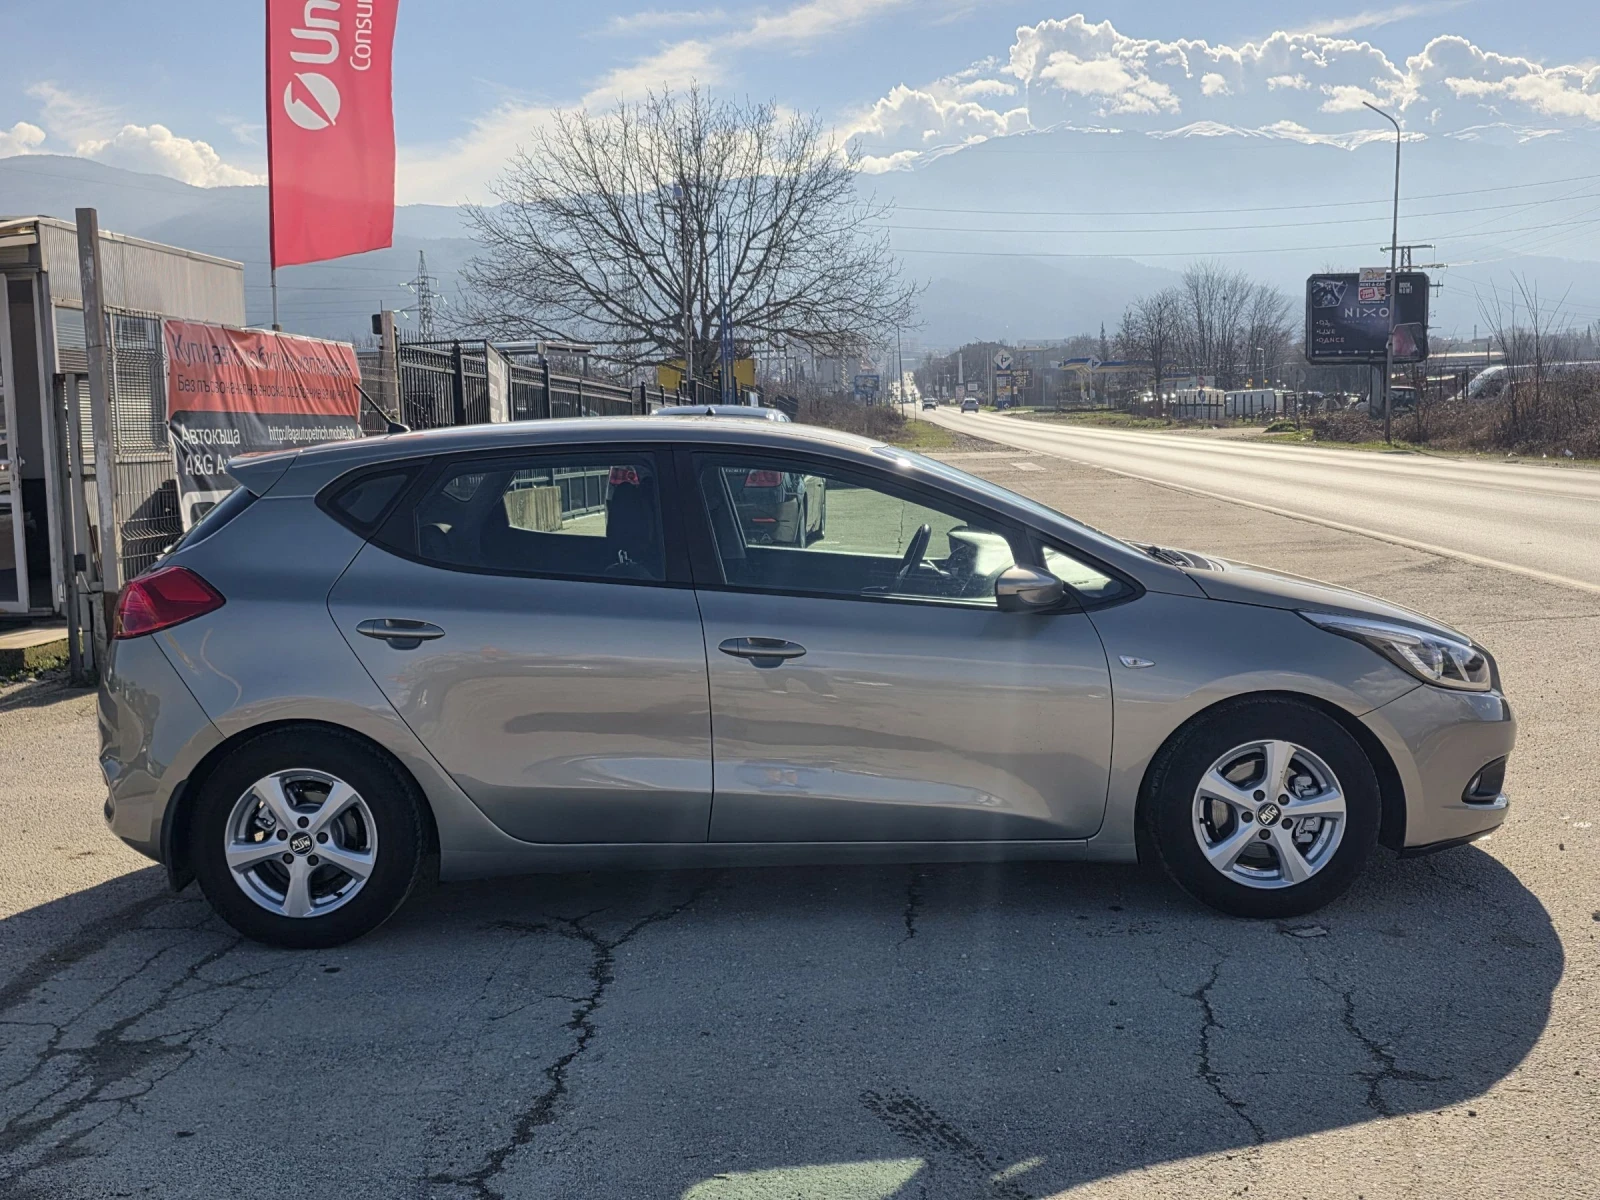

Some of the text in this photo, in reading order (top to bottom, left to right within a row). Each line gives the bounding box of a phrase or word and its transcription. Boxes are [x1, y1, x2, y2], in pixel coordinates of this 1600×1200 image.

[350, 0, 373, 71] Consu
[1344, 307, 1390, 318] NIXO
[172, 334, 210, 367] Купи
[177, 374, 196, 392] Без
[181, 424, 241, 448] Автокъща
[185, 454, 214, 476] A&G
